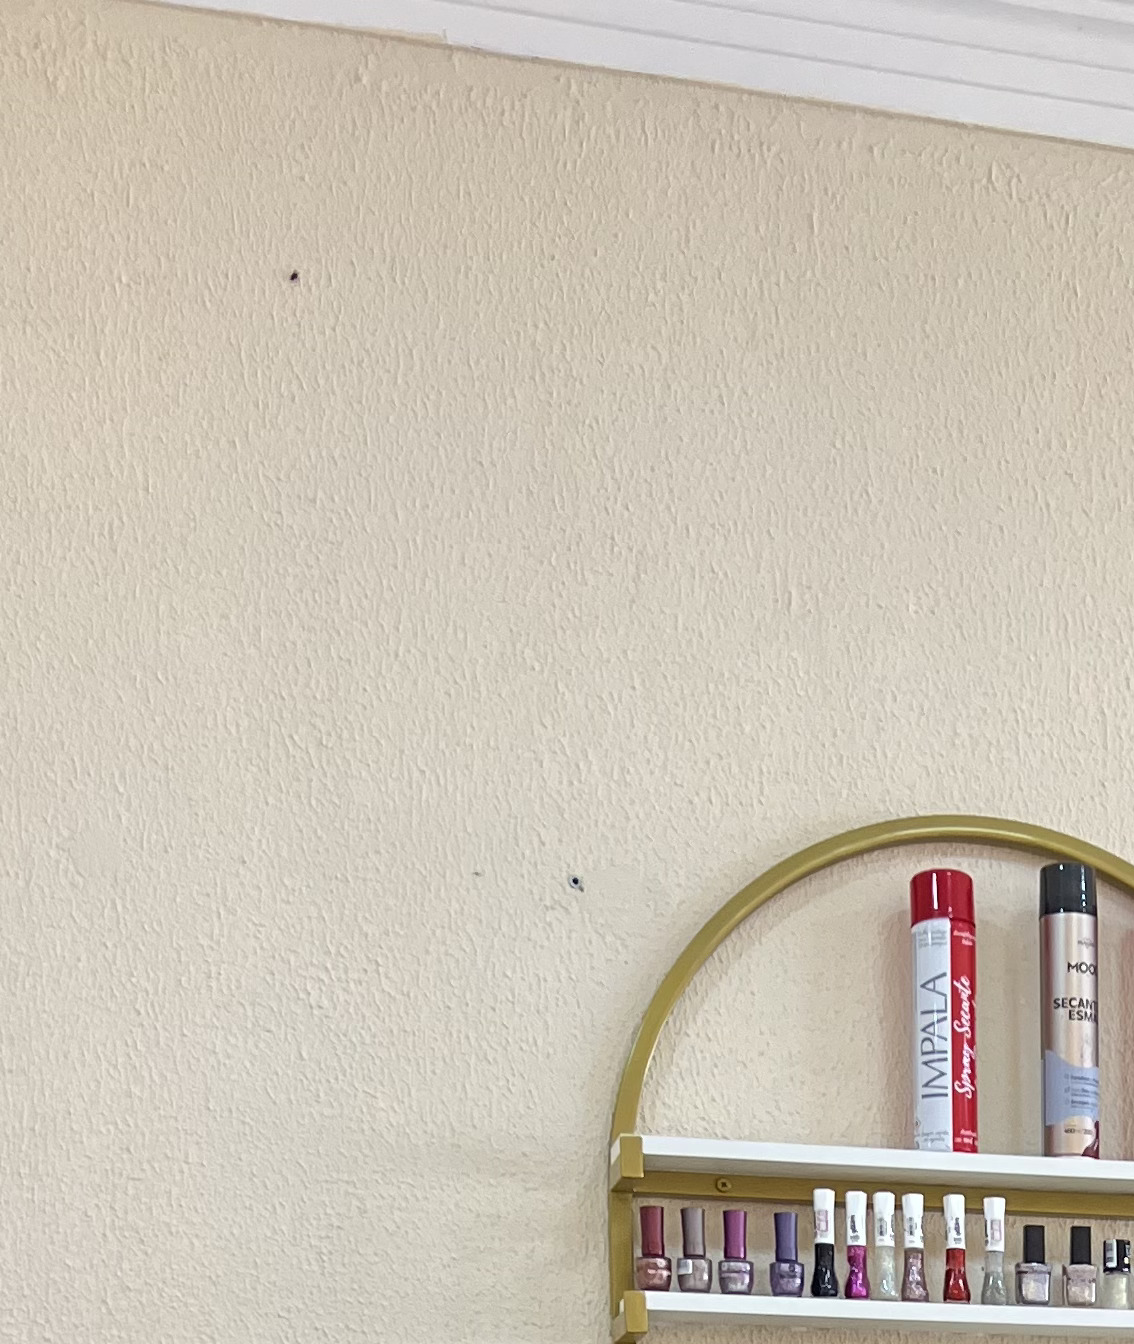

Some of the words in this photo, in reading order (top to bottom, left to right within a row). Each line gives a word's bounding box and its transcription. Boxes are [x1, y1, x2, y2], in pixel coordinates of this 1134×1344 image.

[920, 972, 948, 1100] IMPALA
[953, 975, 971, 1039] Secante
[953, 1041, 975, 1099] Spray
